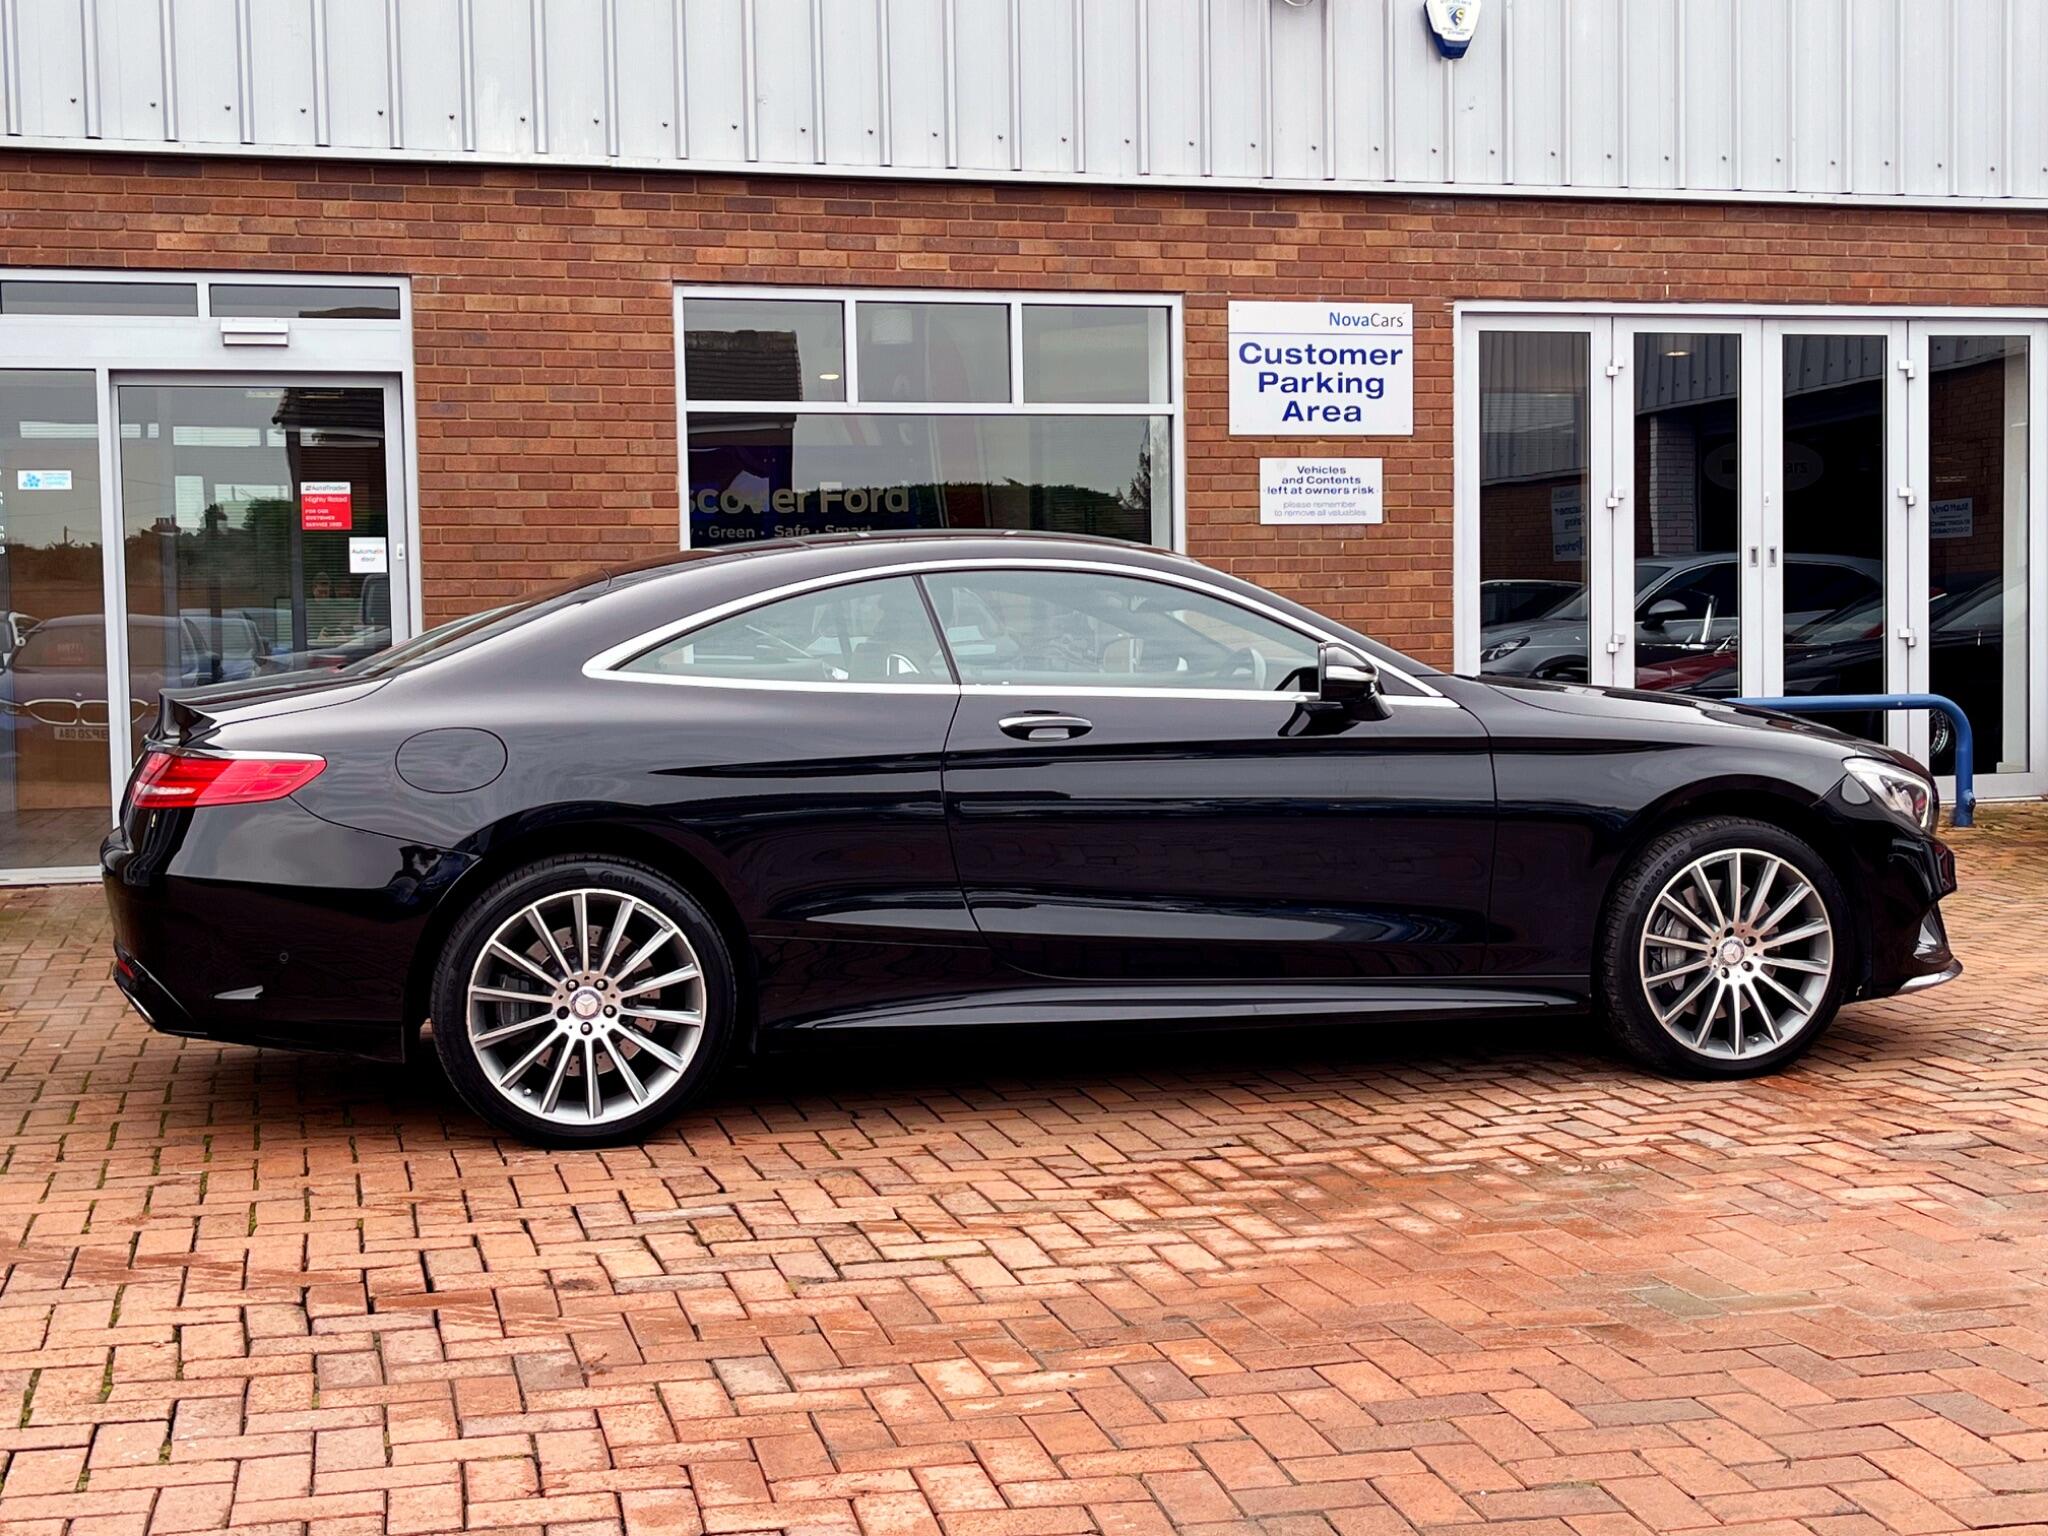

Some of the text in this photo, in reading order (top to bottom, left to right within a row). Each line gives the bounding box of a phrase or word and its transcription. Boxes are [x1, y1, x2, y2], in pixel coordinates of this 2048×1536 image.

[1329, 311, 1403, 328] NovaCars
[1238, 342, 1403, 366] Customer
[1258, 371, 1384, 400] Parking
[1281, 400, 1362, 422] Area
[1296, 465, 1347, 475] Vehicles
[1281, 475, 1361, 485] and Contents
[819, 481, 910, 513] Ford
[1267, 486, 1375, 495] left at owners risk
[1283, 501, 1312, 509] please
[708, 525, 755, 538] Green
[774, 524, 810, 538] Safe
